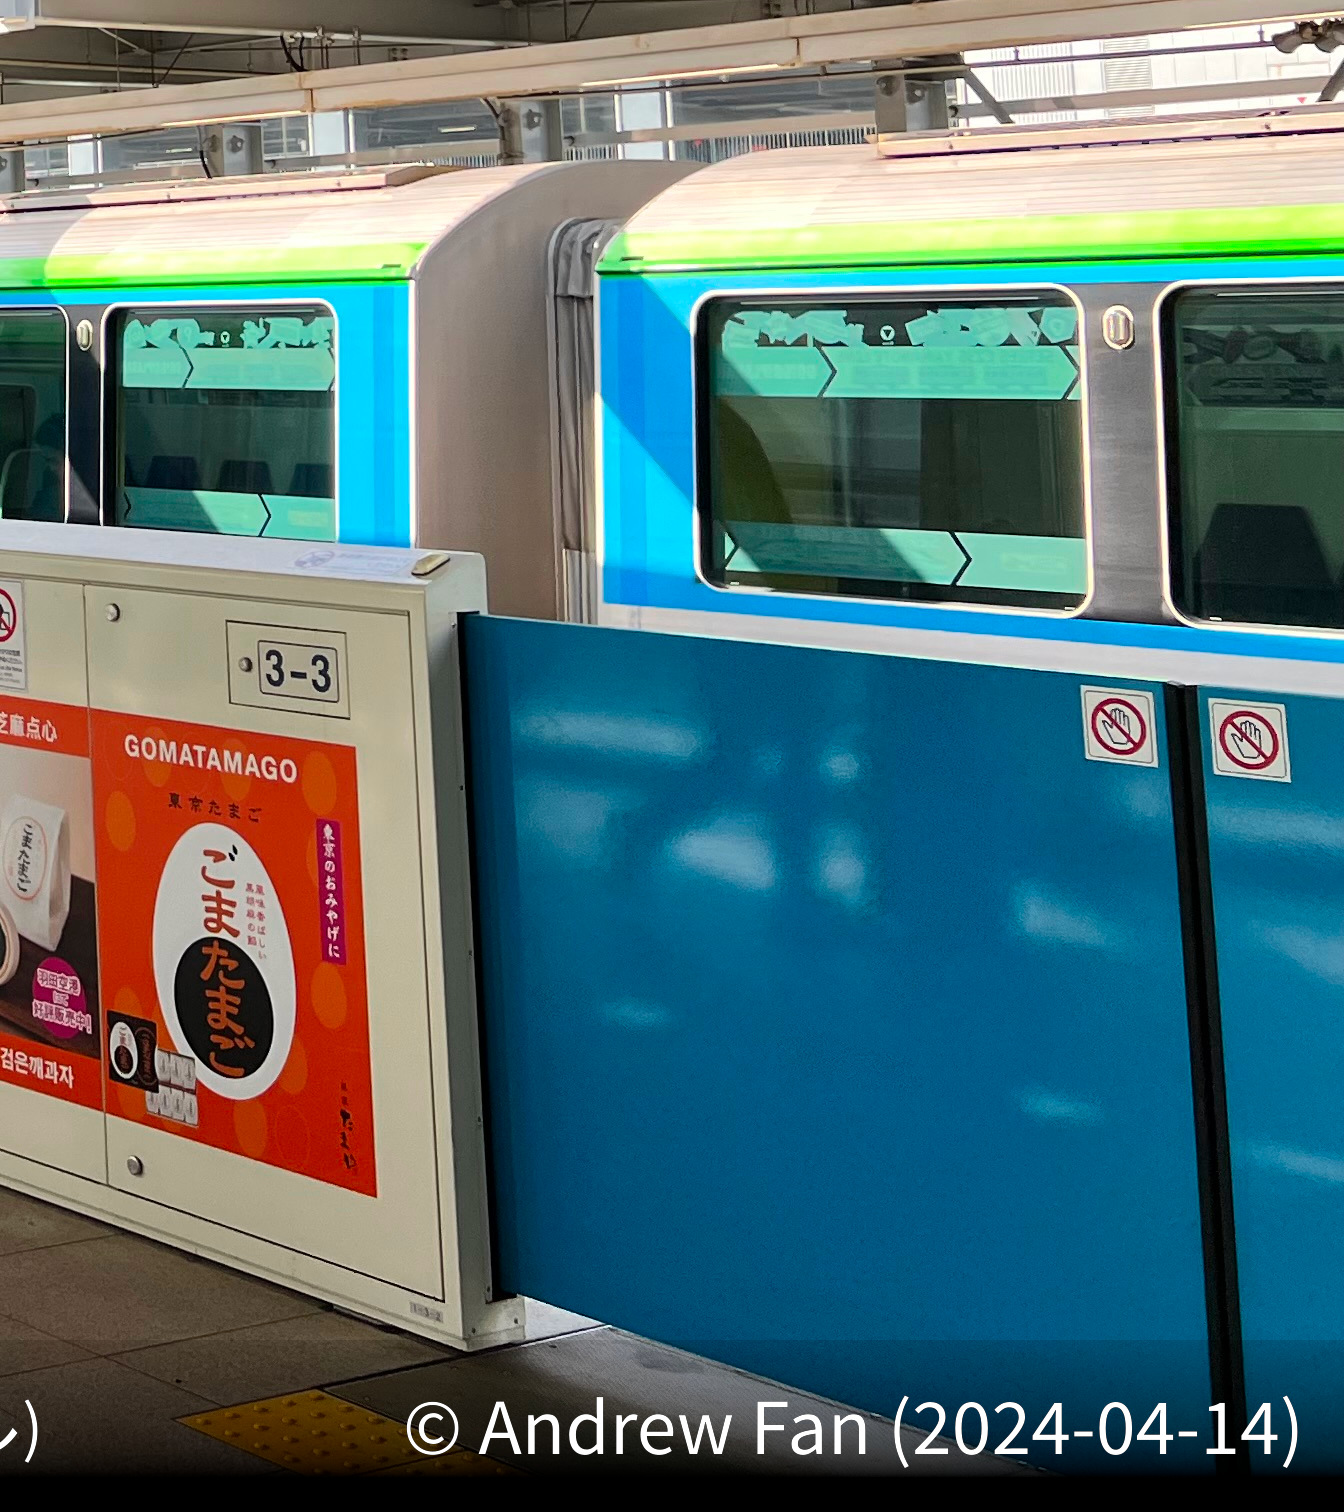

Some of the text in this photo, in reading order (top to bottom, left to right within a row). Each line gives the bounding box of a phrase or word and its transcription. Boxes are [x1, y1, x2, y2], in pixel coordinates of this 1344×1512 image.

[265, 649, 332, 693] 3-3
[124, 734, 298, 783] GOMATAMAGO
[169, 792, 262, 823] 東京たまご
[322, 822, 340, 959] 東京のおみやげに
[199, 844, 256, 1077] ごまたまご
[0, 1046, 75, 1089] 검은깨과자
